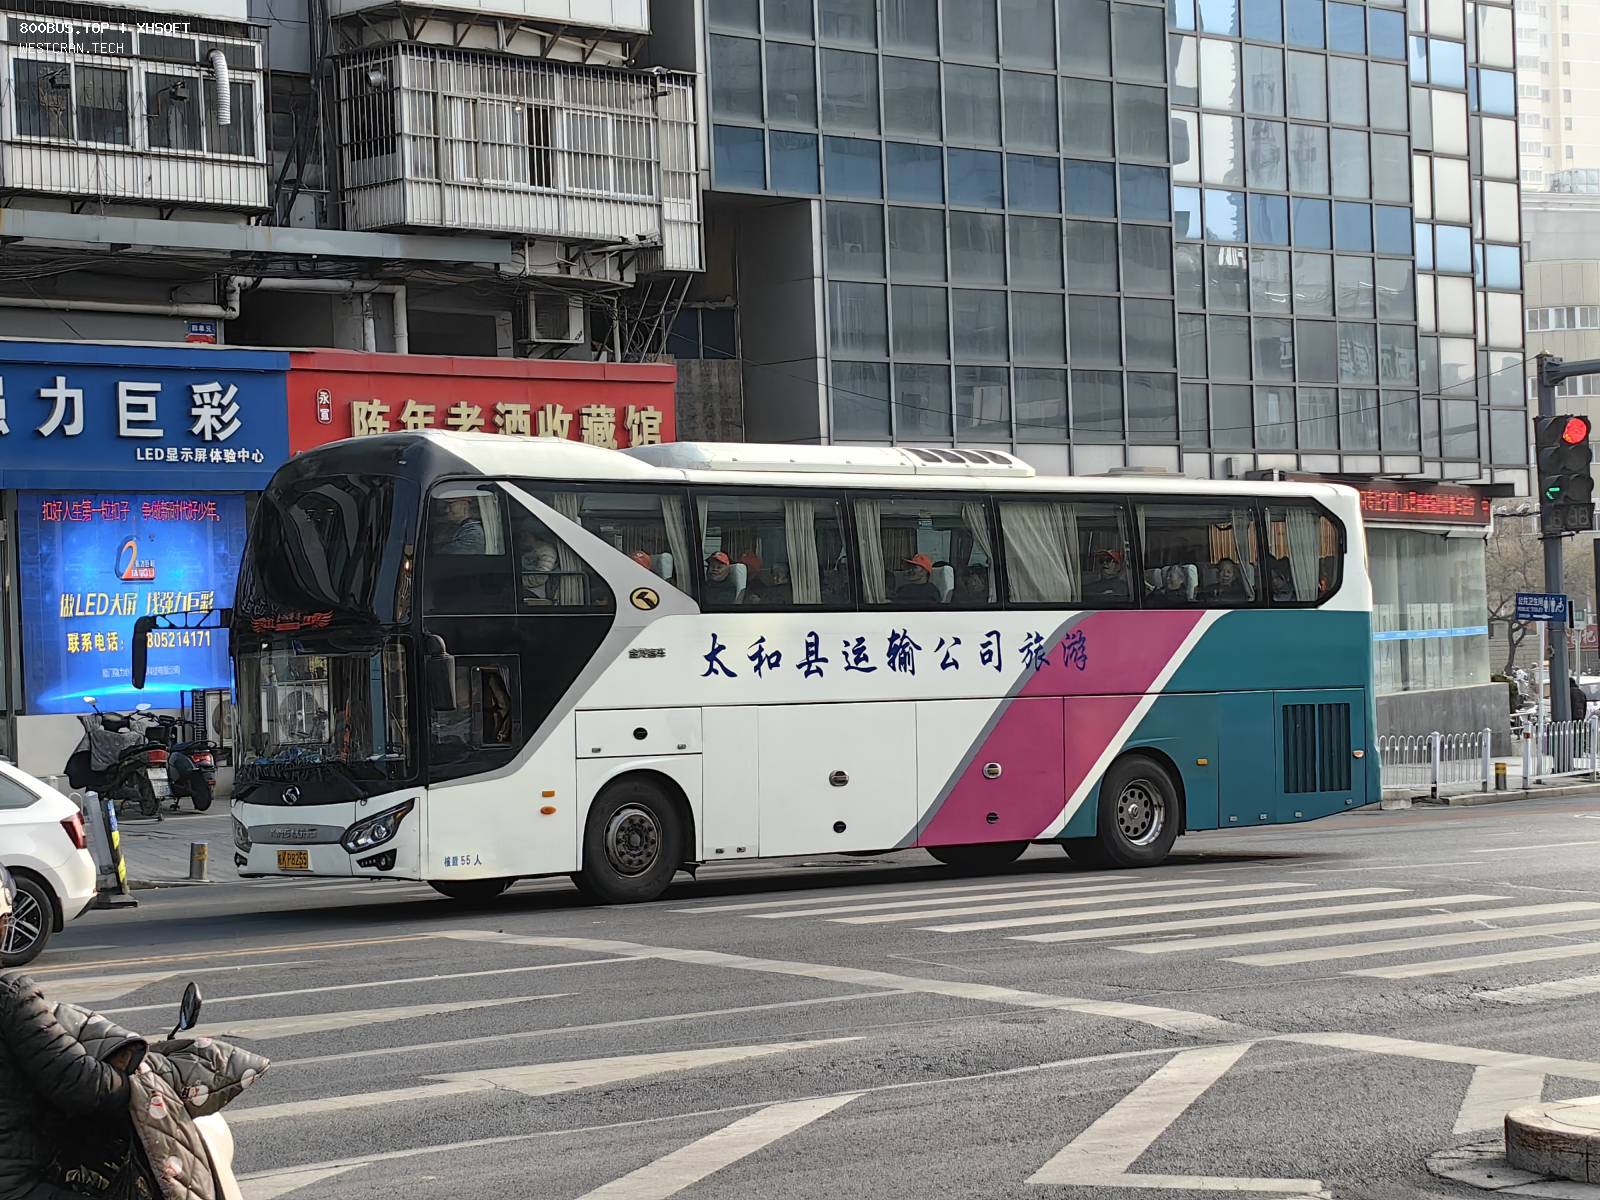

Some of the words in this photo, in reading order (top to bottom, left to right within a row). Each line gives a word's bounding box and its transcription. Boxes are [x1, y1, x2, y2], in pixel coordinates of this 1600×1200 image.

[349, 399, 664, 449] 陈年老酒收藏馆
[136, 447, 265, 464] LED显示屏体验中心
[700, 629, 1089, 678] 太和县运输公司旅游
